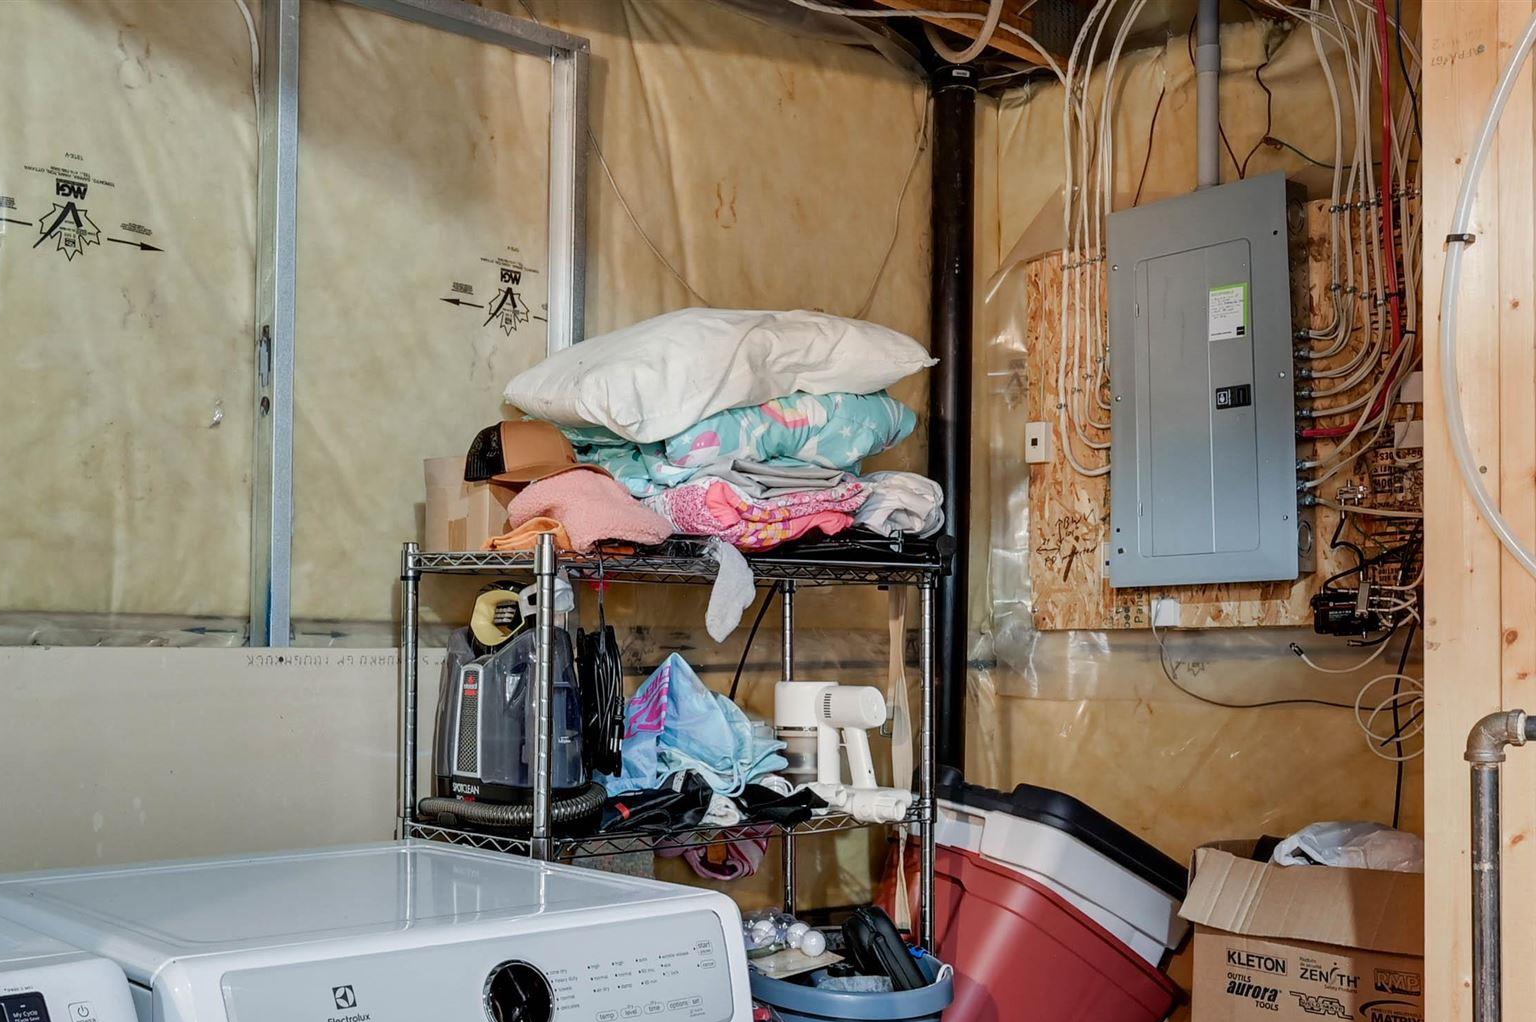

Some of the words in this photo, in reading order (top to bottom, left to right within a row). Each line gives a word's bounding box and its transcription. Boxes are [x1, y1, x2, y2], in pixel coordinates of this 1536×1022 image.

[1227, 950, 1286, 974] KLETON
[1227, 972, 1251, 983] OUTILS
[1227, 980, 1279, 1002] aurora
[1255, 1000, 1279, 1011] TOOLS
